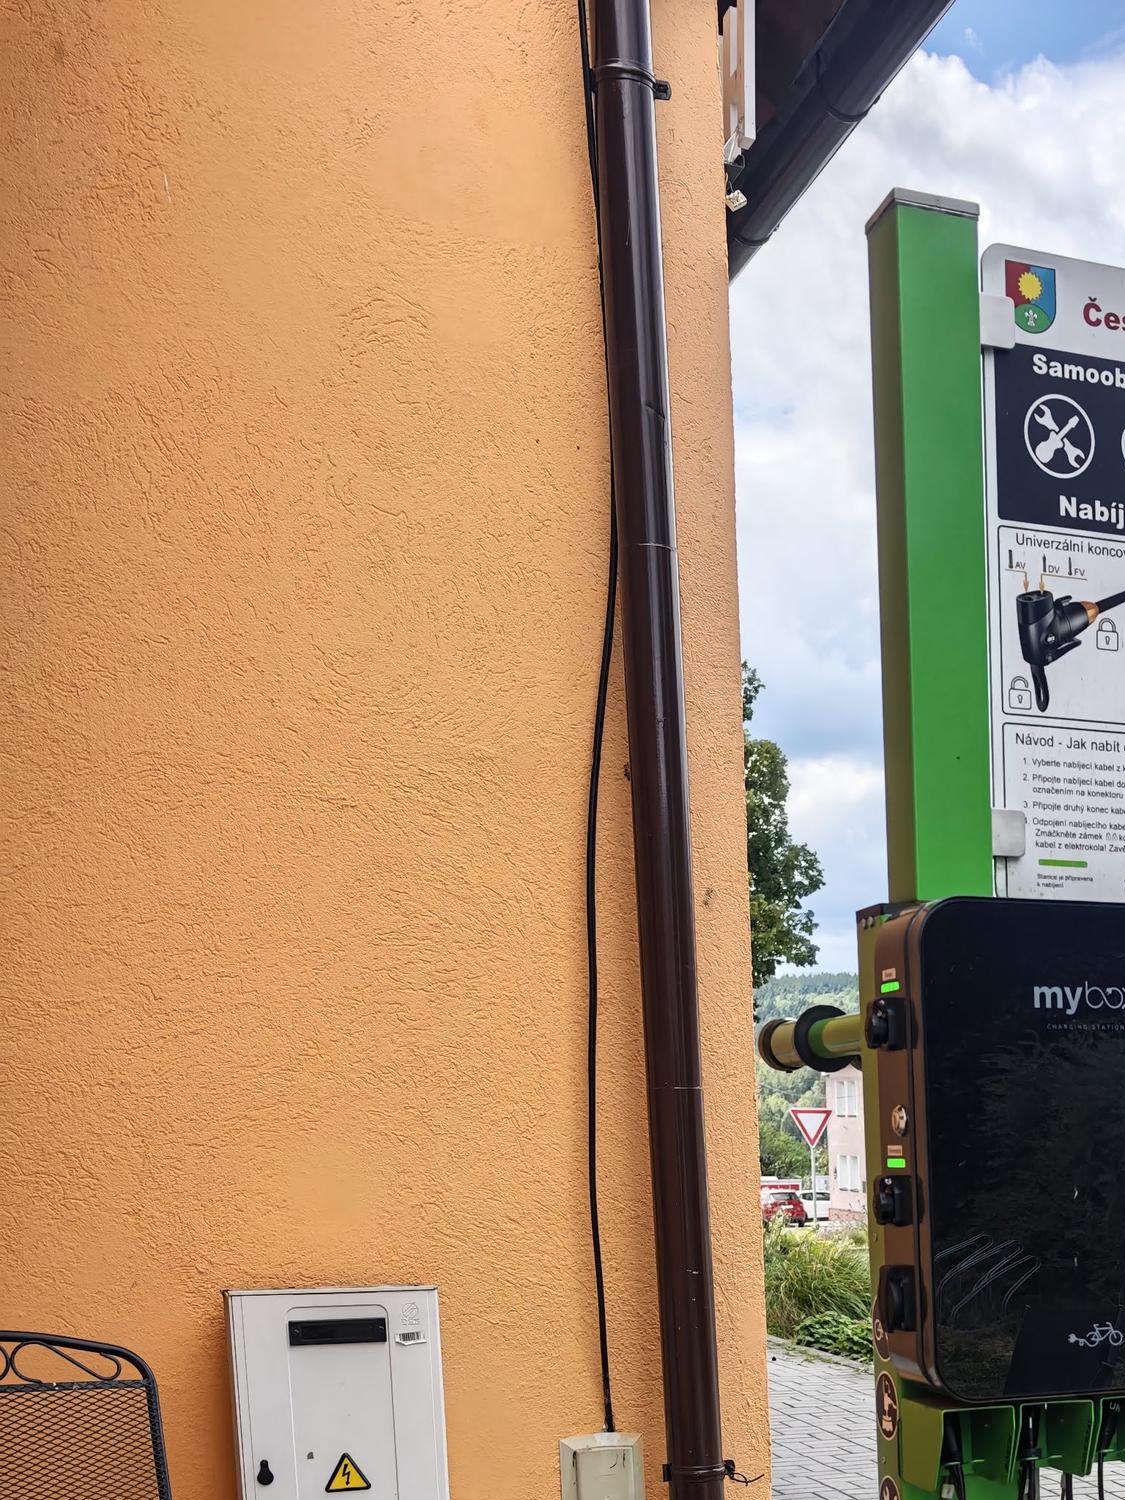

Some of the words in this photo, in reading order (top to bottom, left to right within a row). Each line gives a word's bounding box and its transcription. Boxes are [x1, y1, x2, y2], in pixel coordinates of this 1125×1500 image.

[1015, 532, 1085, 554] Univerzální
[1015, 561, 1026, 570] AV
[1048, 565, 1060, 574] DV
[1015, 733, 1054, 748] Návod
[1066, 737, 1087, 751] Jak
[1090, 740, 1120, 753] nabít
[1031, 758, 1061, 769] Vyberte
[1063, 760, 1092, 771] nabíjecí
[1094, 762, 1115, 772] kabel
[1023, 773, 1029, 782] 2.
[1032, 773, 1061, 785] Připojte
[1063, 776, 1092, 787] nabíjecí
[1094, 778, 1115, 788] kabel
[1116, 780, 1125, 789] do
[1032, 786, 1074, 797] označením
[1075, 789, 1085, 797] na
[1087, 789, 1123, 800] konektoru
[1032, 800, 1061, 812] Připojte
[1063, 803, 1085, 814] druhý
[1086, 805, 1109, 814] konec
[1032, 816, 1067, 828] Odpojení
[1069, 819, 1107, 831] nabíjecího
[1035, 828, 1077, 840] Zmáčkněte
[1078, 831, 1103, 841] zámek
[1035, 841, 1056, 850] kabel
[1057, 842, 1063, 850] z
